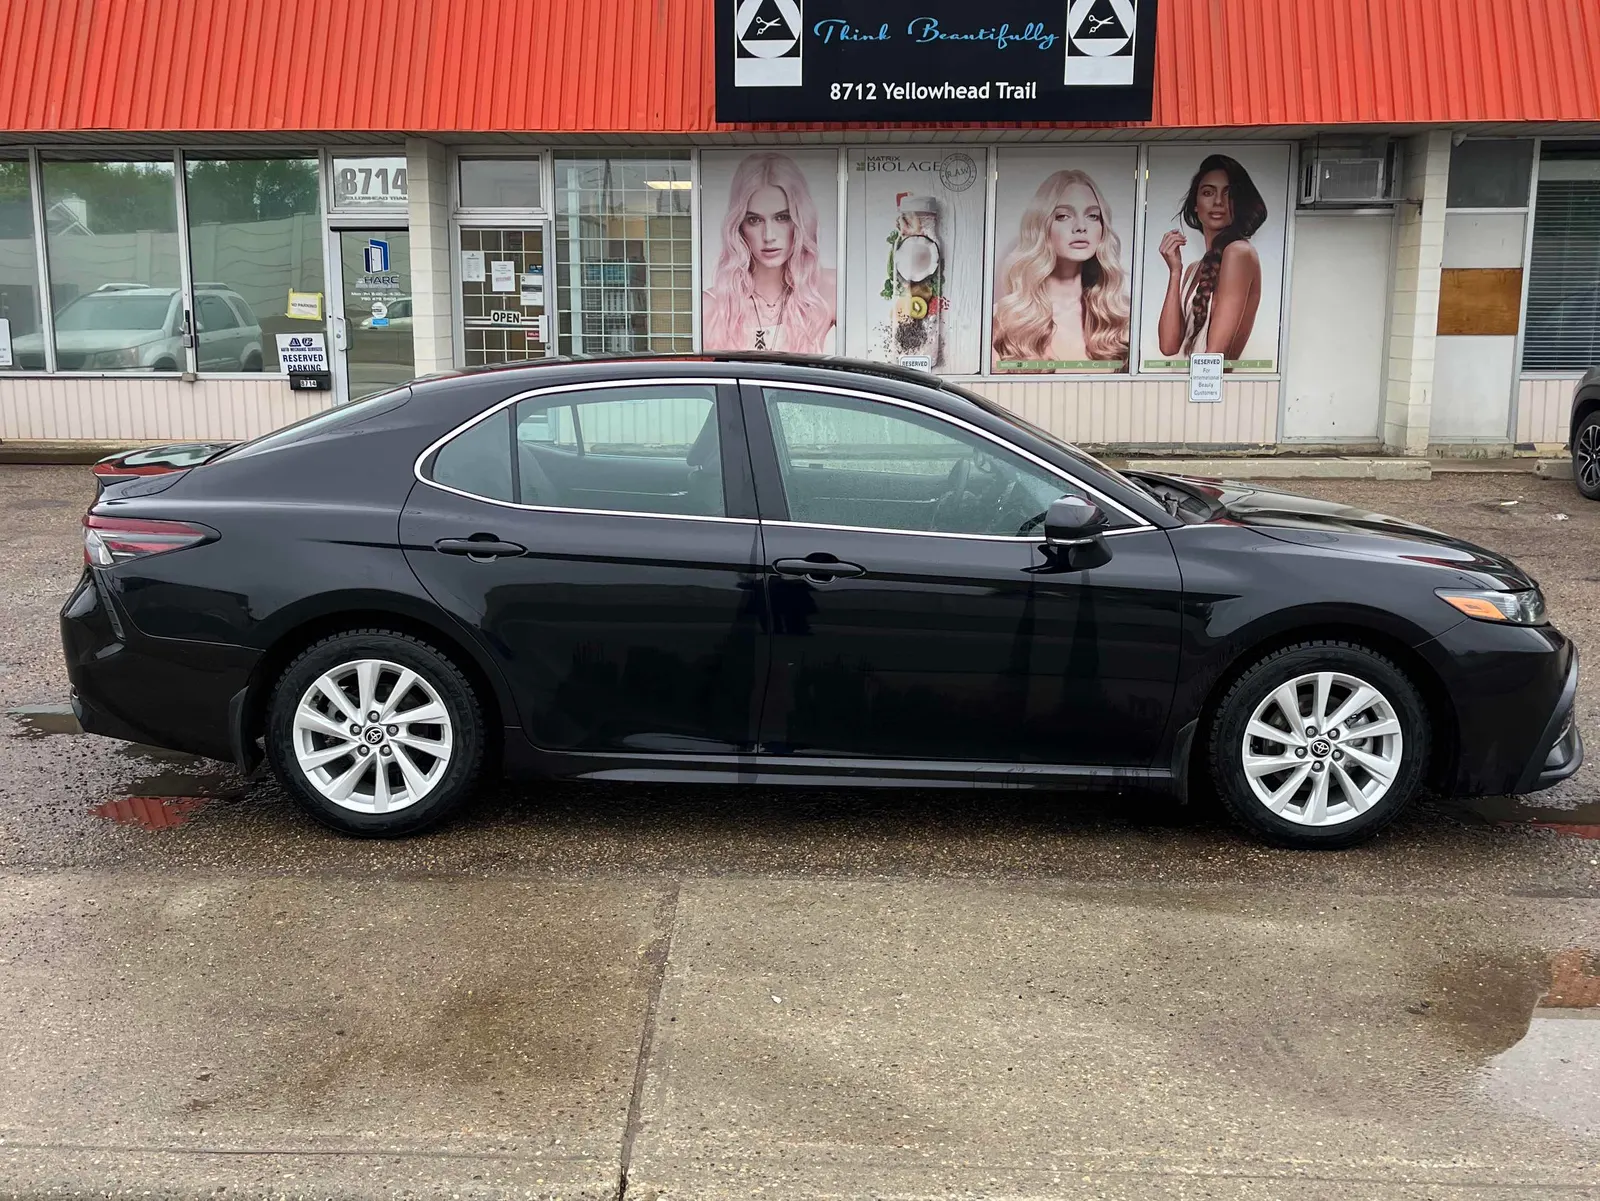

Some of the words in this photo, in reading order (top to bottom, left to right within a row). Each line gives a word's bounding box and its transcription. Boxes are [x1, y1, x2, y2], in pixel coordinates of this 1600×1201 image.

[813, 19, 892, 44] Think
[907, 16, 1060, 50] Beautifully
[830, 82, 877, 100] 8712
[882, 81, 990, 100] Yellowhead
[996, 81, 1037, 99] Trail
[867, 161, 941, 172] BIOLAGE
[340, 168, 408, 195] 8714
[364, 276, 399, 285] HARC
[492, 312, 520, 323] OPEN
[283, 354, 324, 362] RESERVED
[287, 364, 322, 372] PARKING
